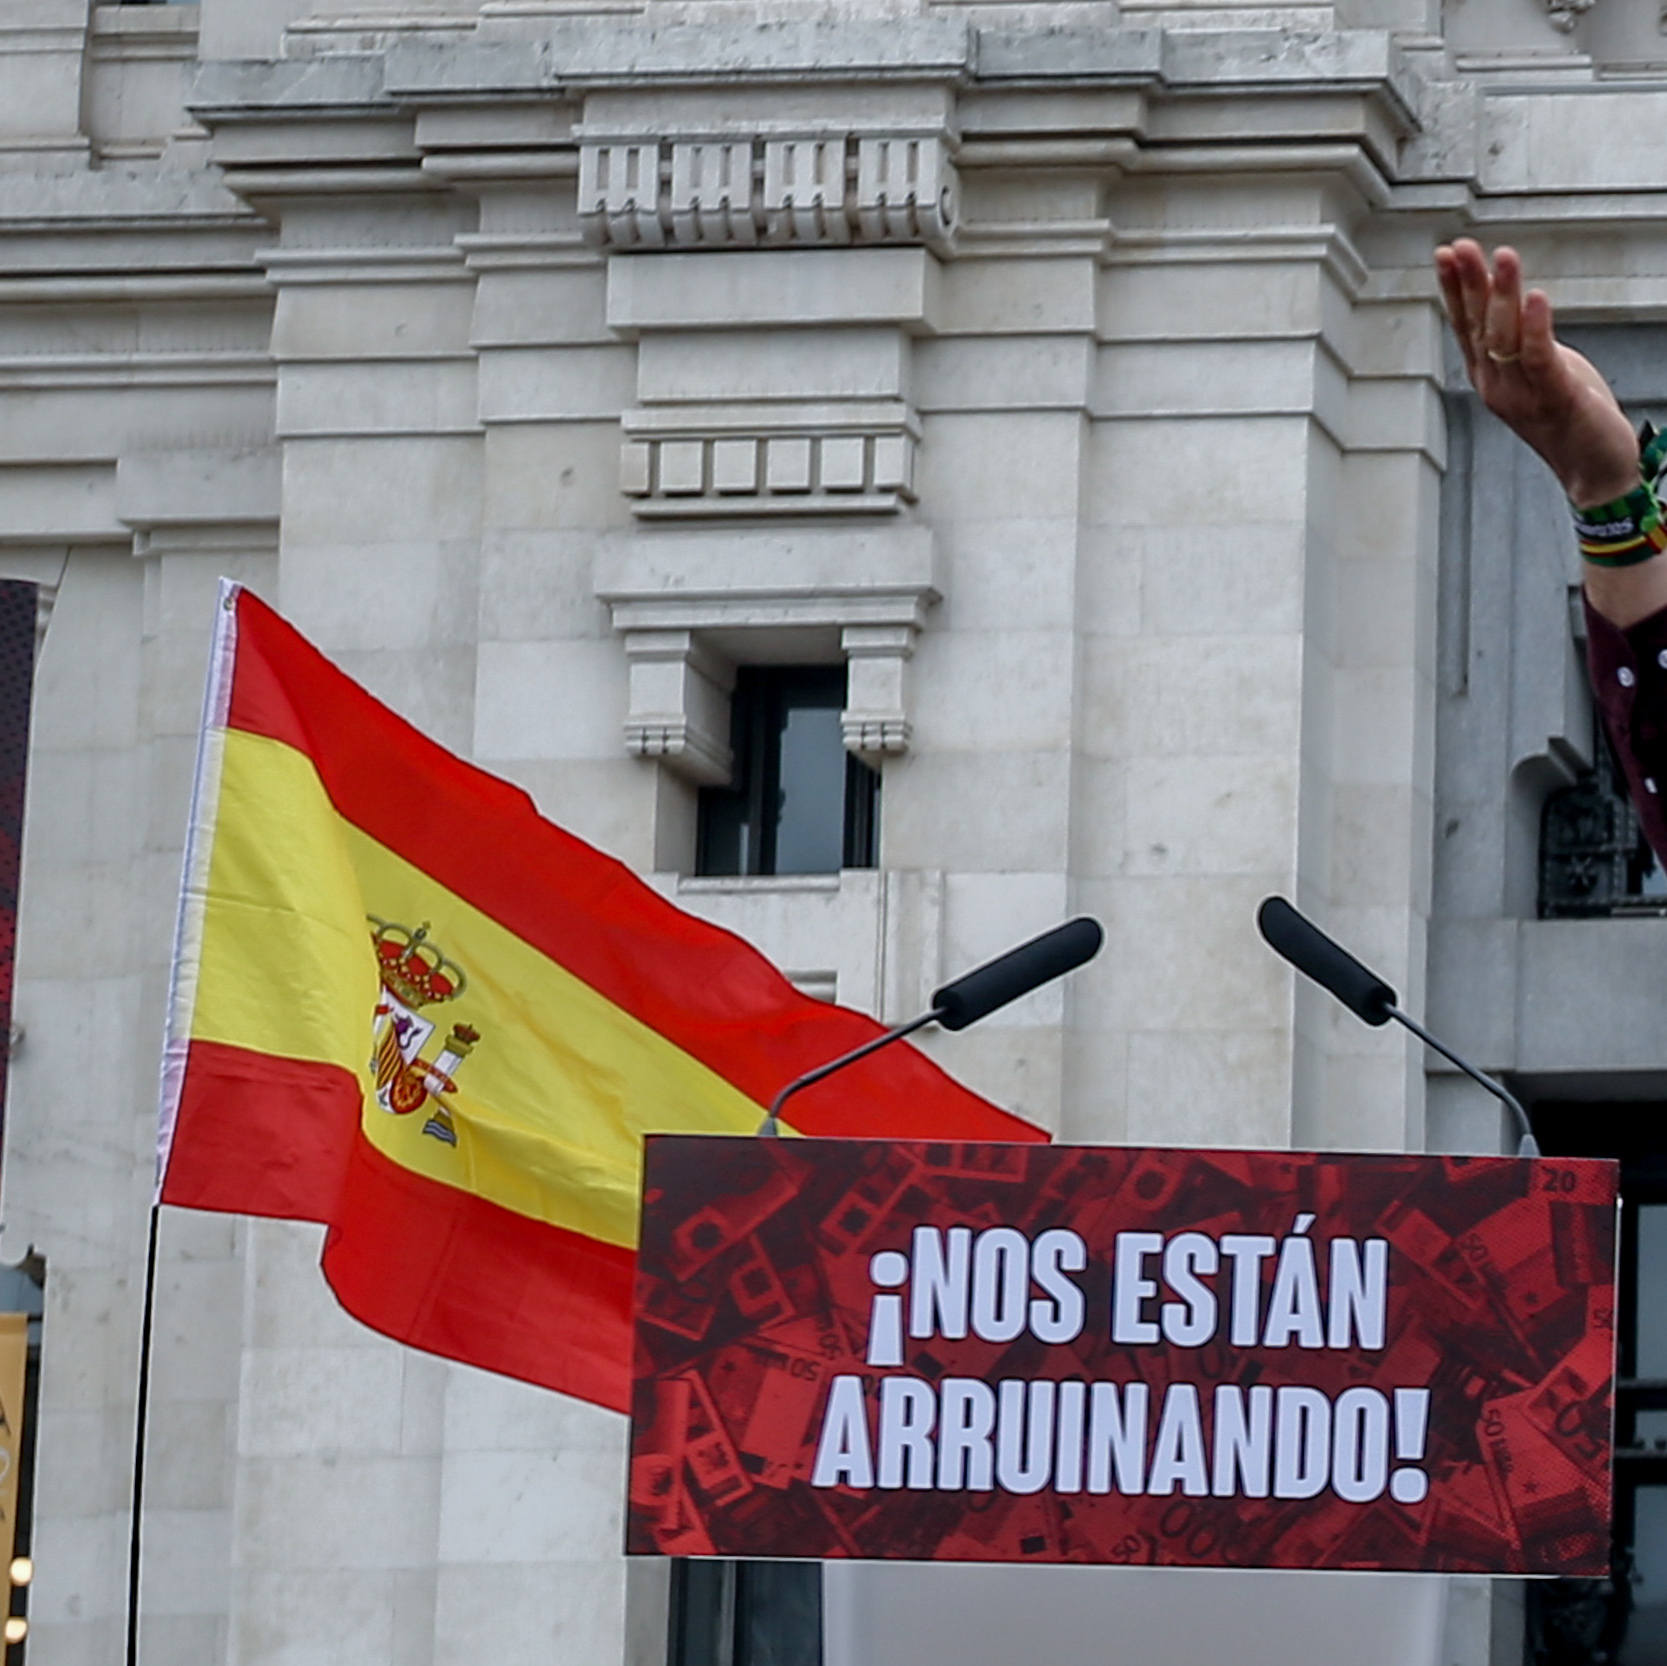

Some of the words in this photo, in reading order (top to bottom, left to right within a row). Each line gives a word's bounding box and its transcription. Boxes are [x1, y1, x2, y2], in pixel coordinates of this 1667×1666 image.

[867, 1226, 1087, 1367] ¡NOS
[1112, 1213, 1389, 1351] ESTÁN
[811, 1375, 1431, 1503] ARRUINANDO!
